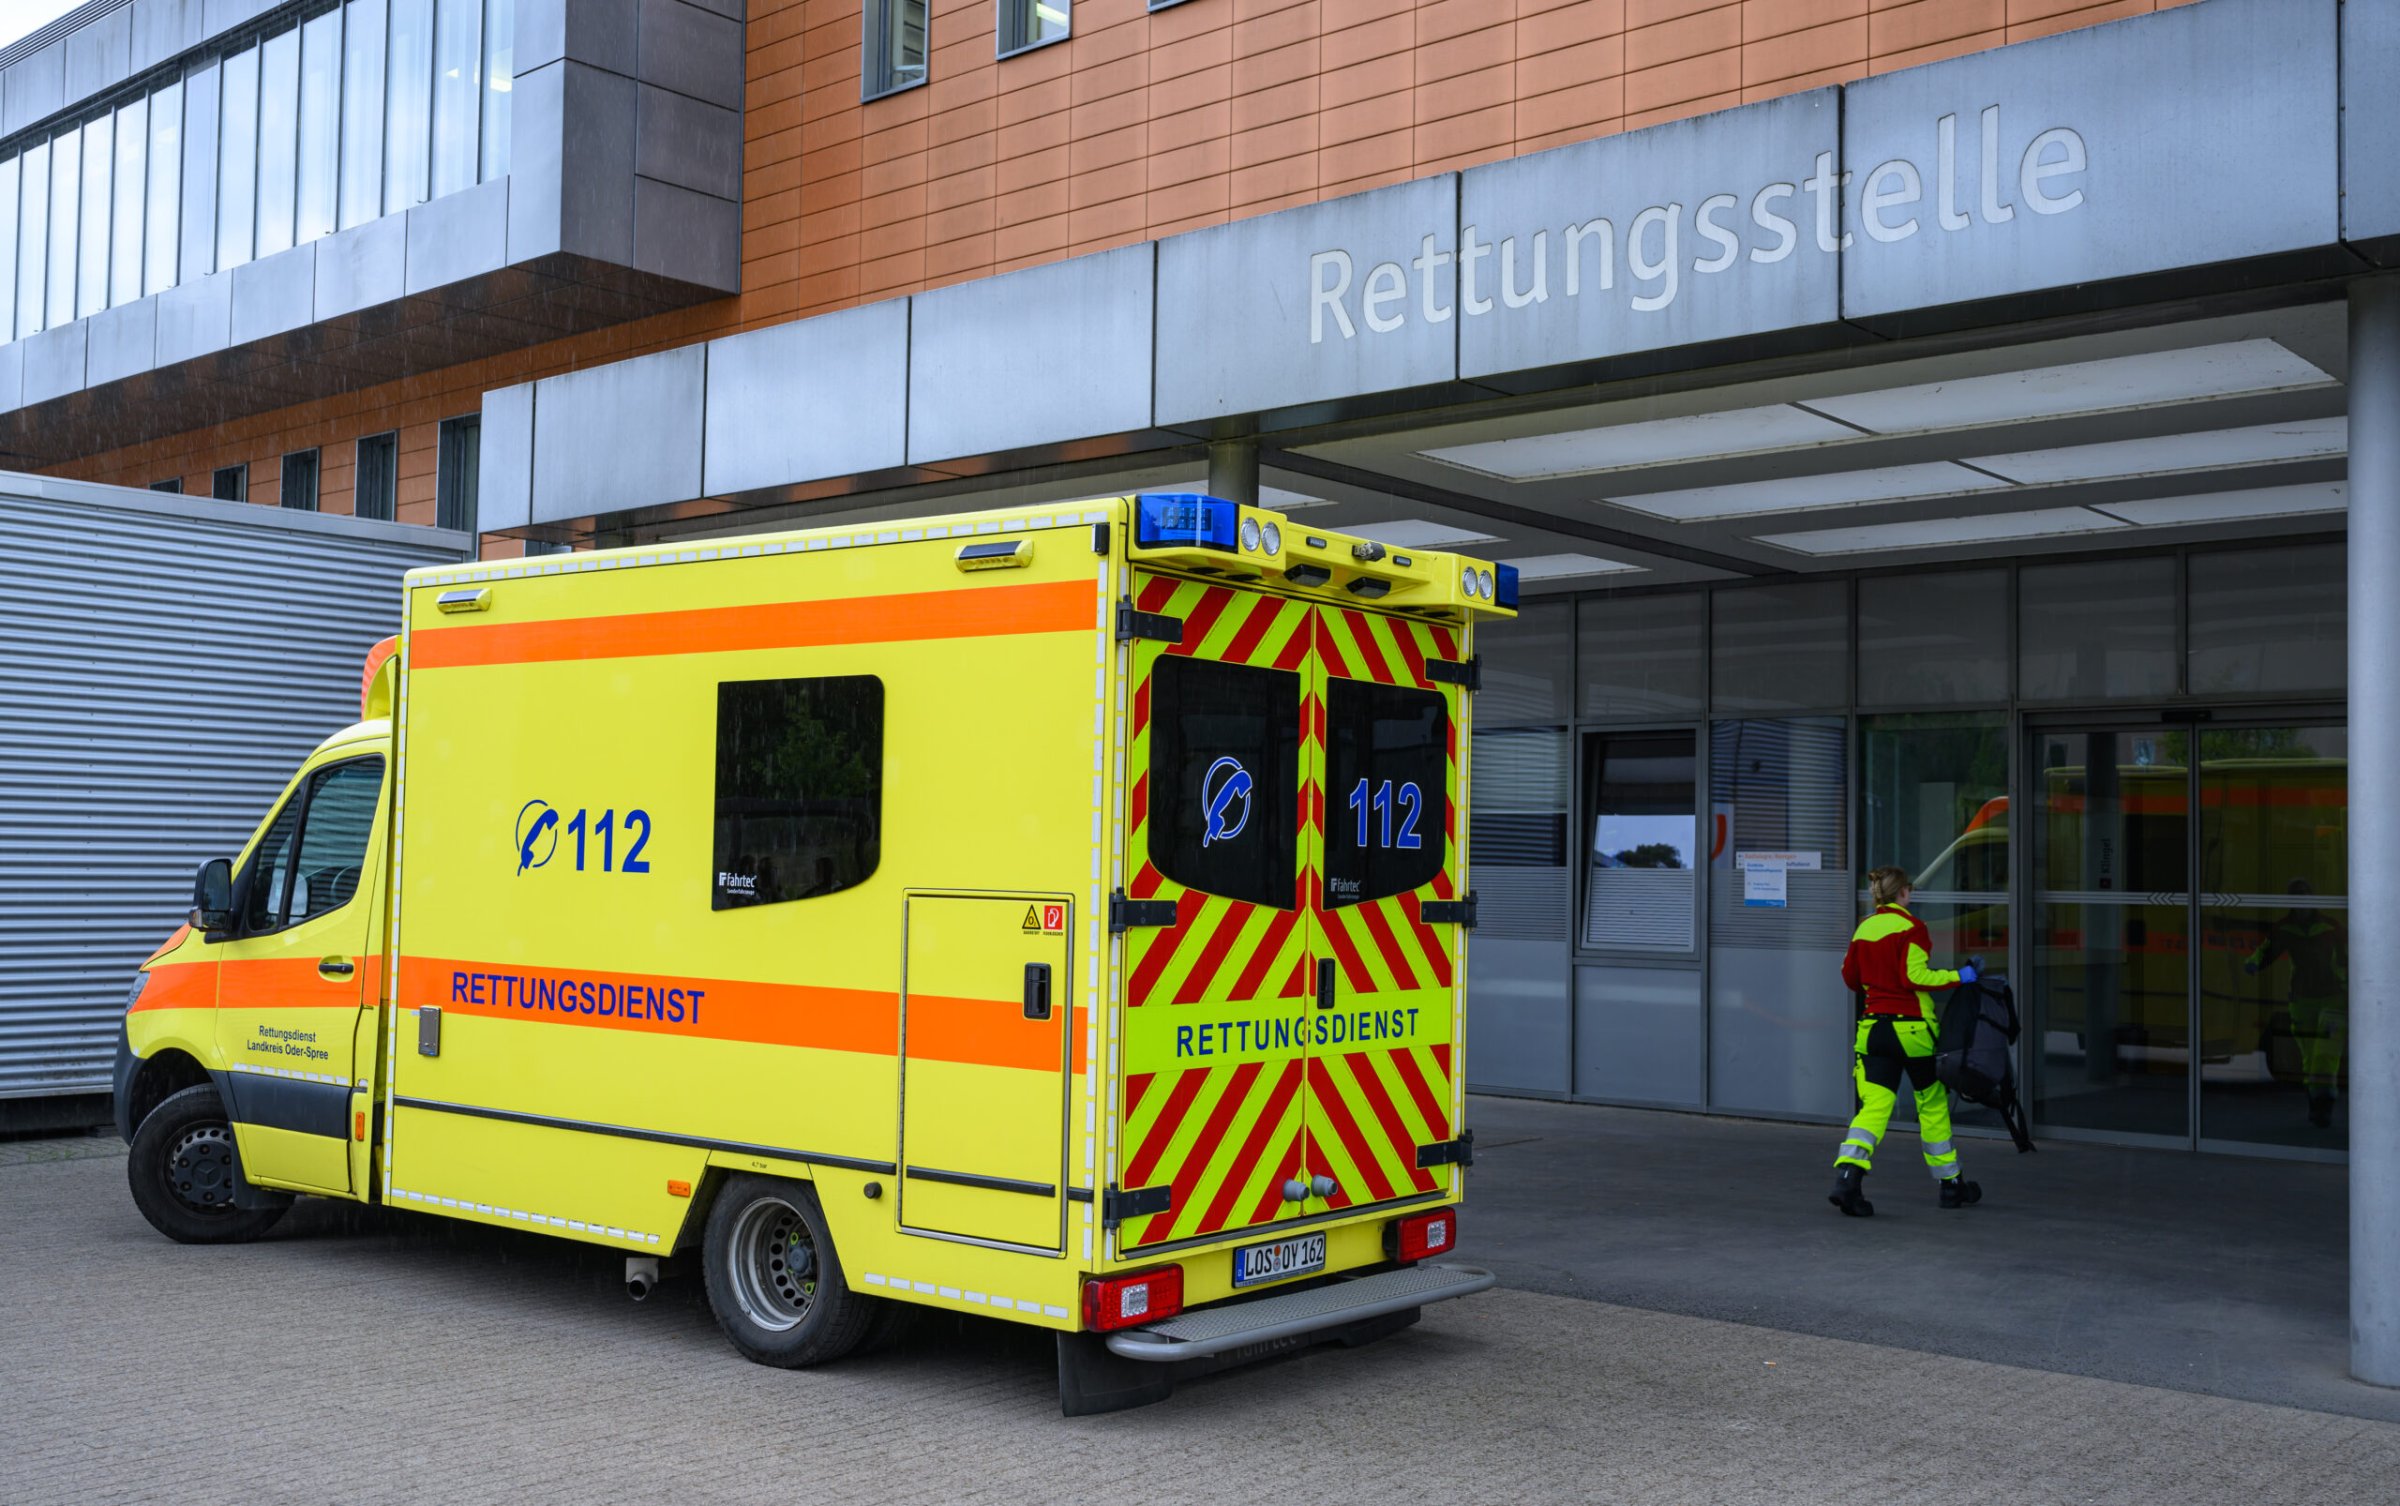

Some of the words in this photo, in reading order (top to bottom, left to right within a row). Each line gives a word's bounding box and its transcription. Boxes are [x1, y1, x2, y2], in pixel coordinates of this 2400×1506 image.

[1309, 104, 2087, 345] Rettungsstelle
[1350, 778, 1421, 849] 112
[568, 808, 651, 873] 112
[452, 972, 705, 1024] RETTUNGSDIENST
[247, 1040, 283, 1054] Landkreis
[285, 1043, 328, 1060] Oder-Spree
[259, 1025, 316, 1042] Rettungsdienst
[1177, 1008, 1419, 1057] RETTUNGSDIENST
[1245, 1248, 1272, 1276] LOS
[1282, 1243, 1298, 1269] OY
[1301, 1238, 1323, 1265] 162
